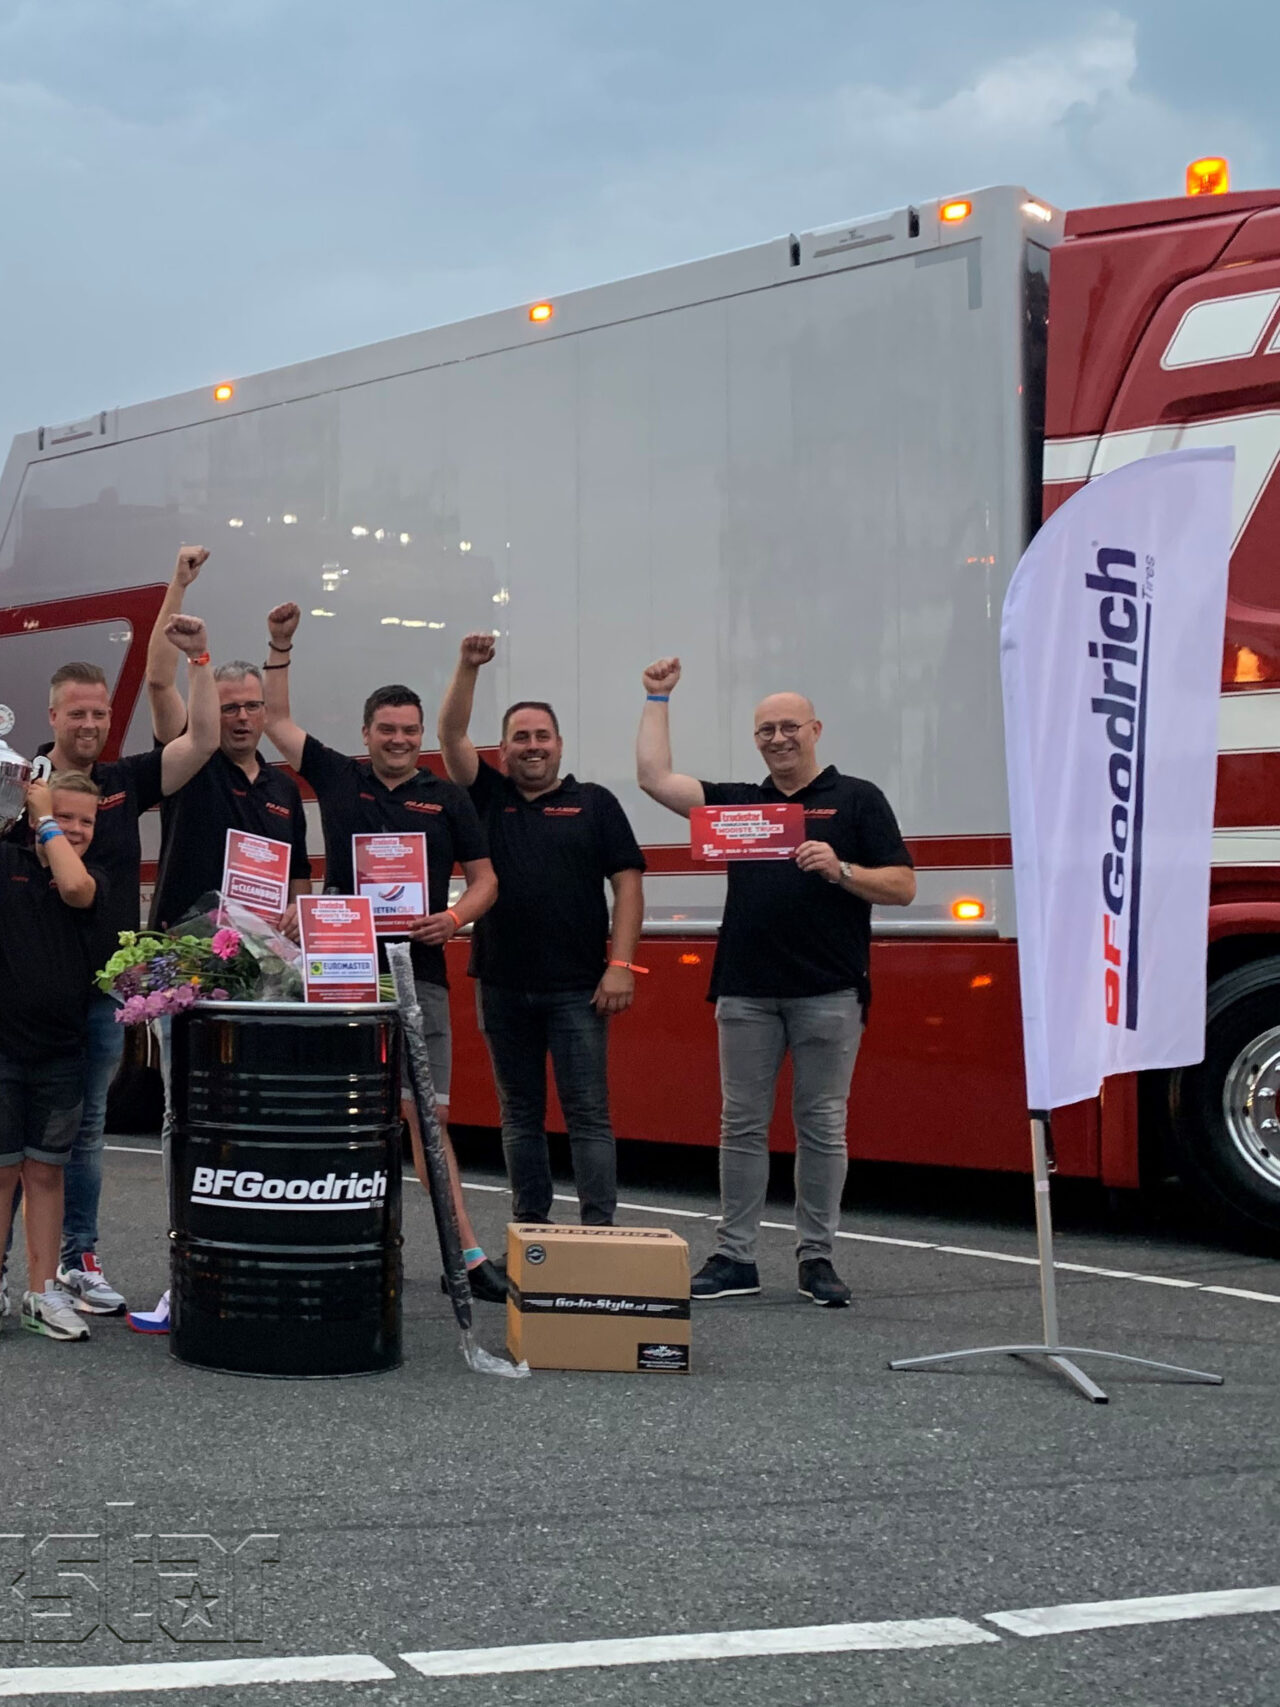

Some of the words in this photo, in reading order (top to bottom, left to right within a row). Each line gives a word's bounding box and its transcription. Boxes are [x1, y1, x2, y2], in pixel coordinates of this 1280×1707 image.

[1141, 554, 1155, 600] Tires
[323, 962, 371, 970] EUROMASTER
[192, 1166, 388, 1200] BFGoodrich
